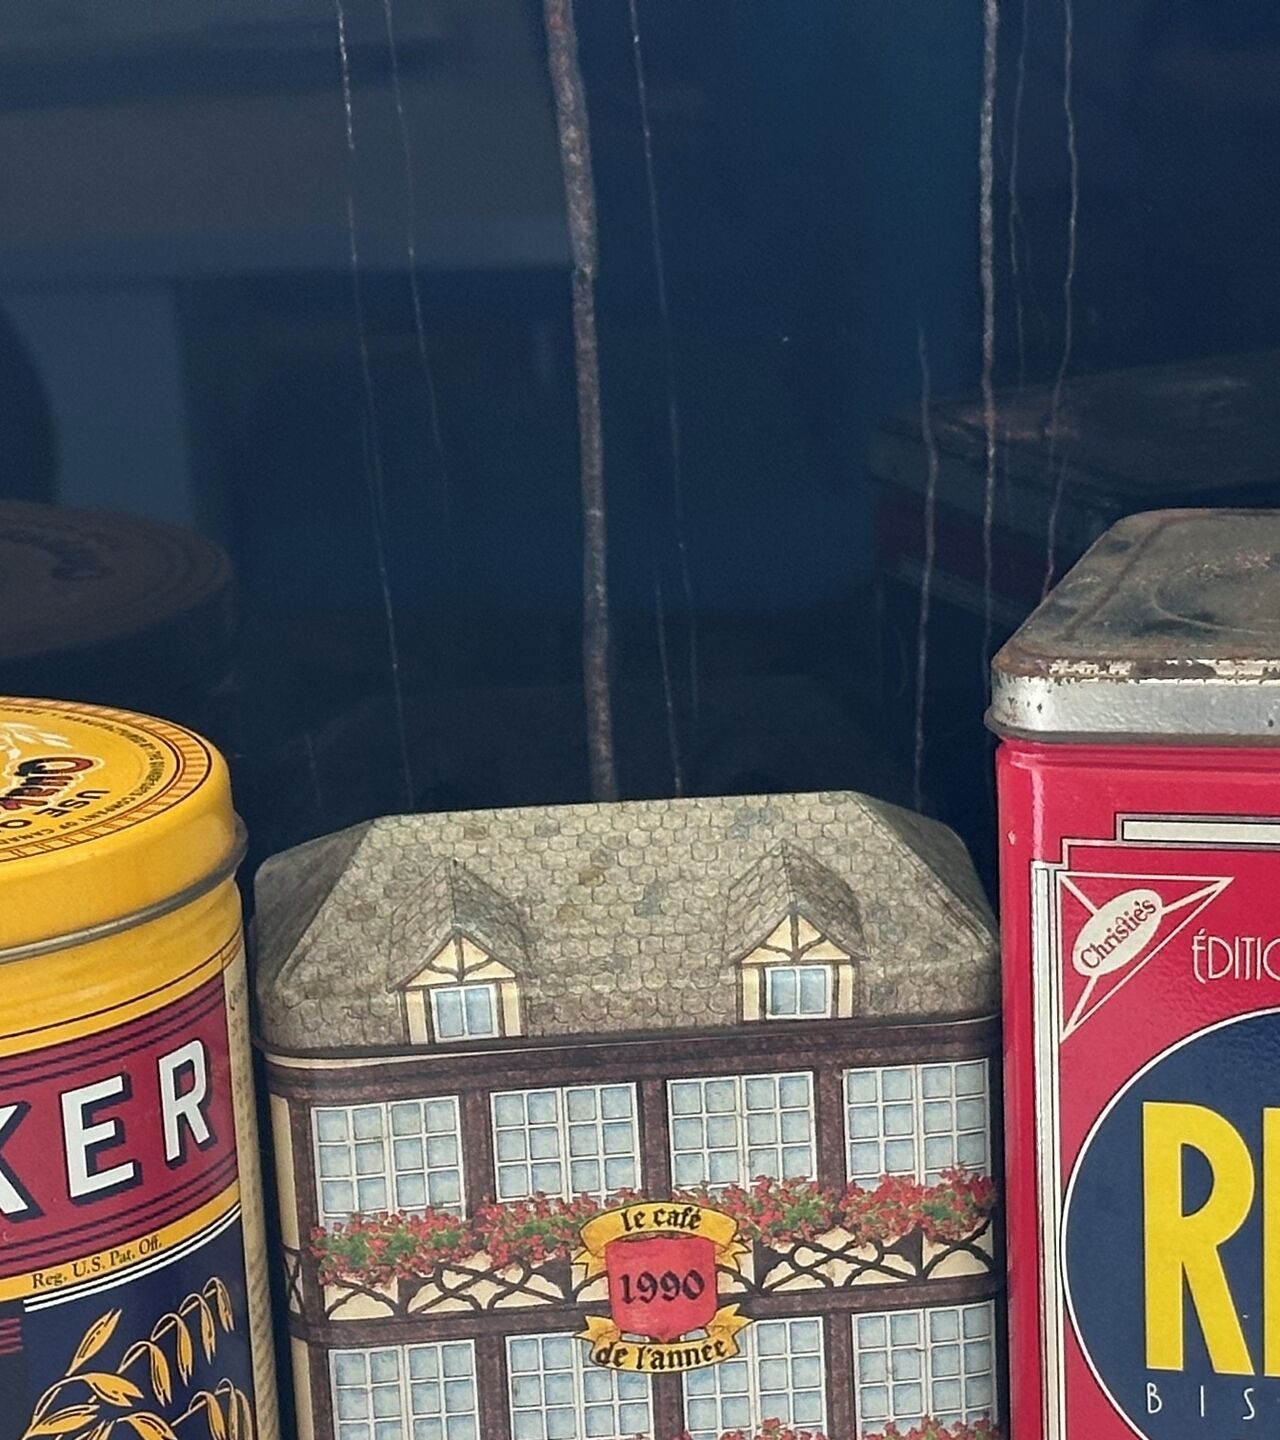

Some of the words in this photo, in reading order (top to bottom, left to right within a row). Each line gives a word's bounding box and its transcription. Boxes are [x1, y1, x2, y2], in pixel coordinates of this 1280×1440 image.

[36, 789, 110, 817] USE
[1080, 896, 1157, 972] Christie's
[620, 1209, 646, 1232] le
[653, 1206, 702, 1230] café
[32, 1272, 67, 1289] Reg.
[72, 1256, 106, 1278] U.S.
[110, 1249, 135, 1267] Pat.
[139, 1234, 162, 1255] Off.
[620, 1269, 705, 1305] 1990
[595, 1342, 629, 1366] de
